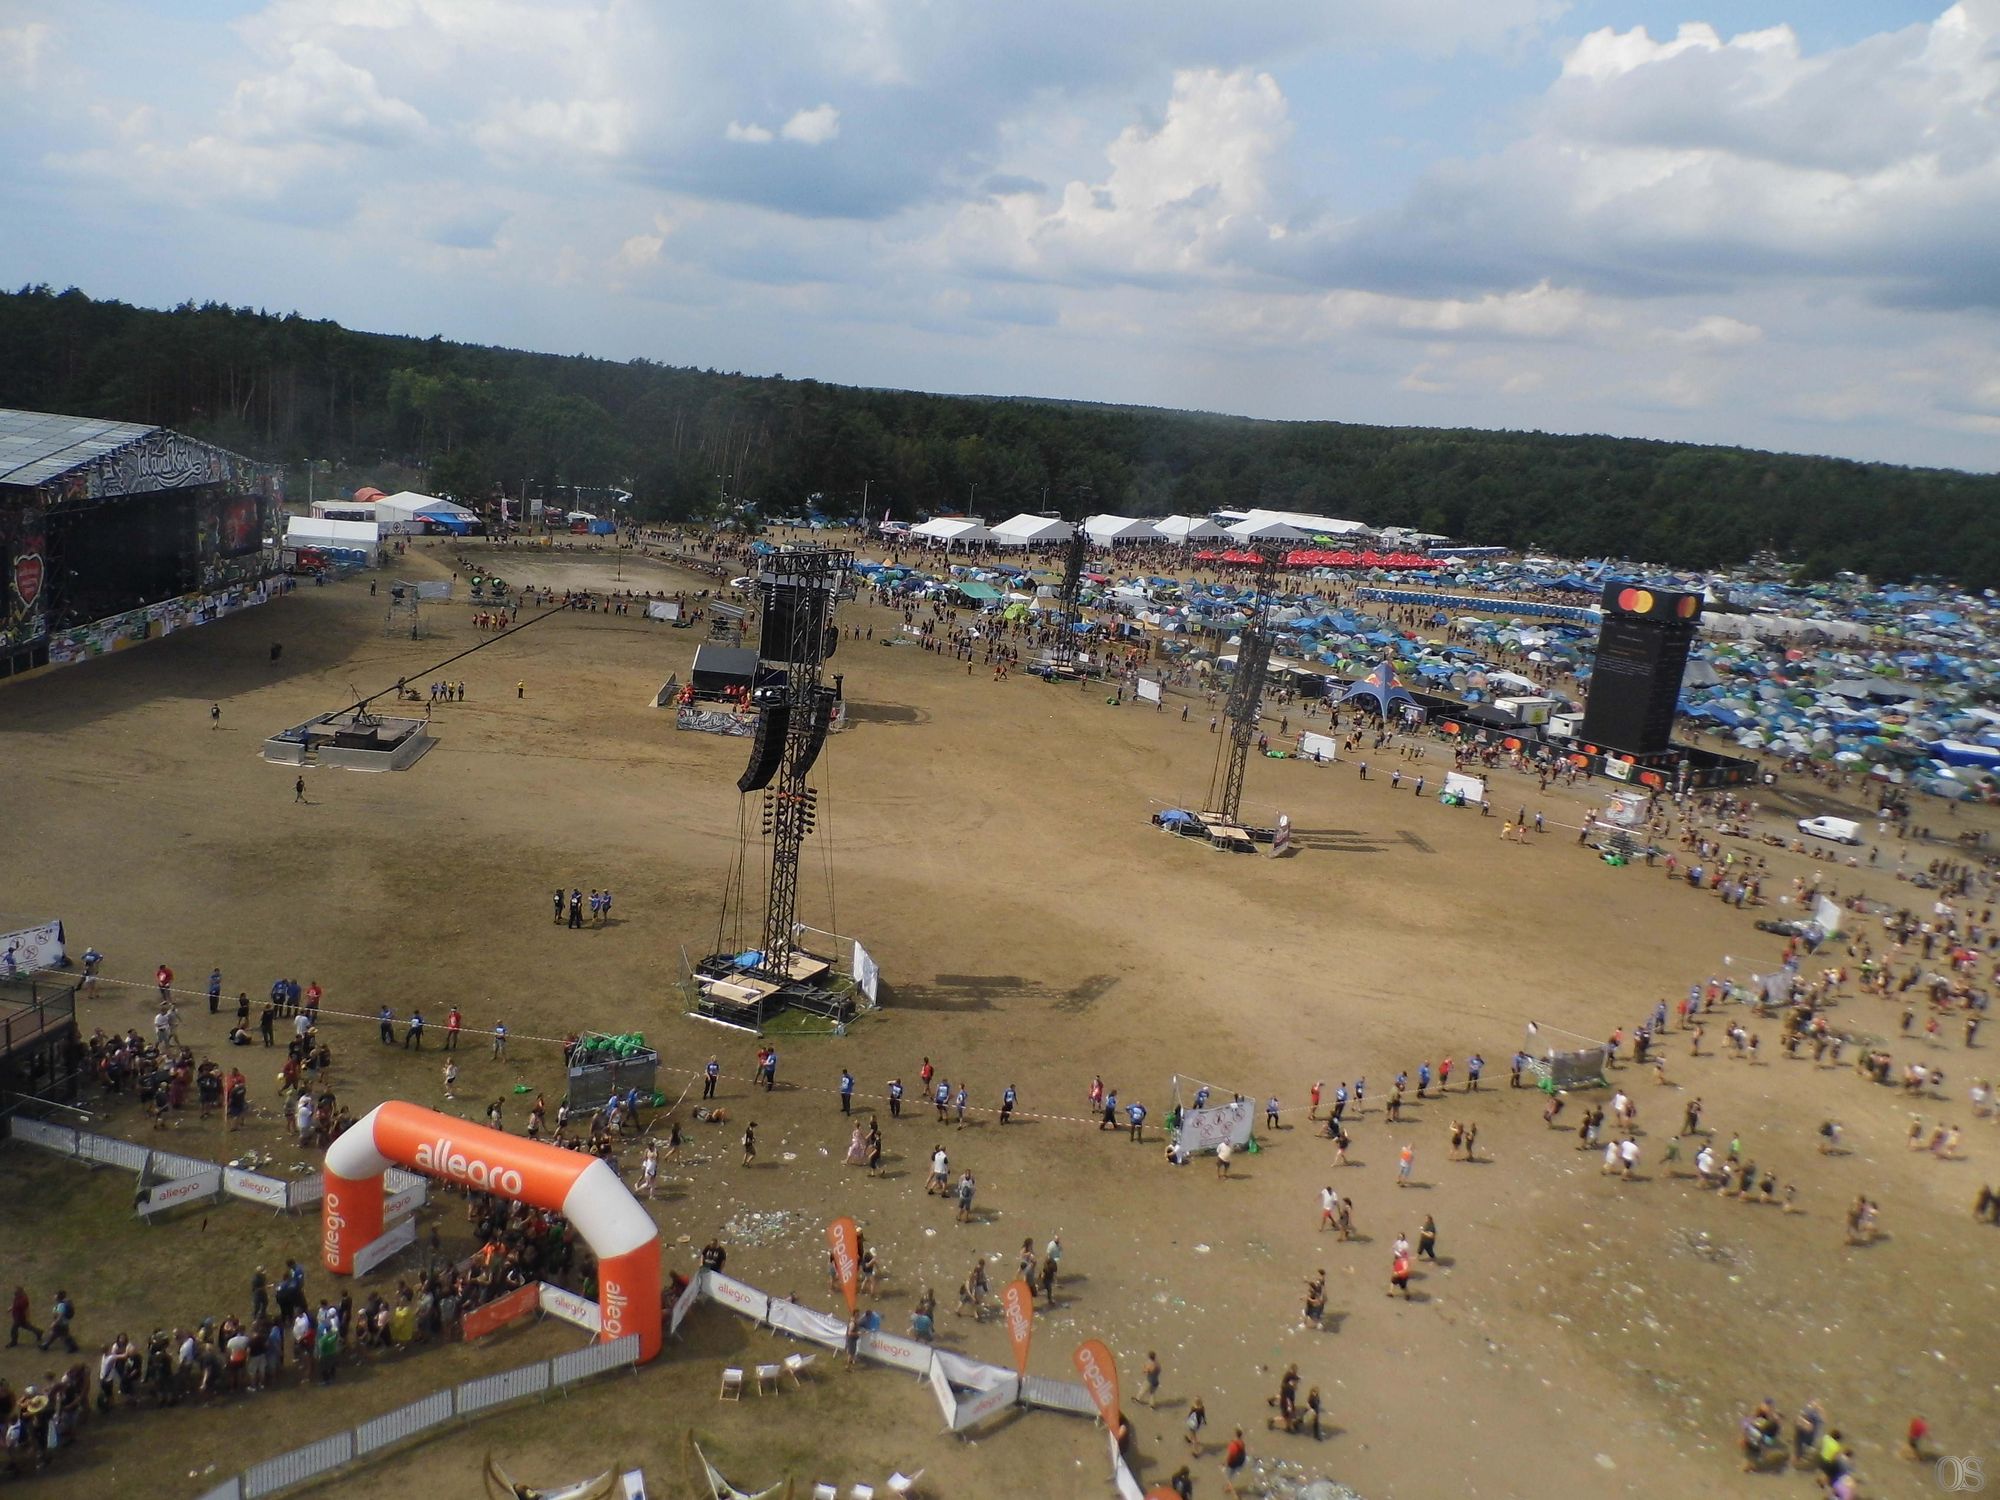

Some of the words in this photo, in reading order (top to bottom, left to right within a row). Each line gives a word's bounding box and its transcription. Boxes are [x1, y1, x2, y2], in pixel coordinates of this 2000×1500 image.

[415, 1138, 522, 1195] allegro
[159, 1181, 200, 1202] allegro
[239, 1178, 271, 1194] allegro
[384, 1197, 411, 1214] llegro
[326, 1193, 346, 1266] allegro
[719, 1283, 751, 1303] allegro
[554, 1298, 587, 1317] allegro
[870, 1338, 910, 1358] allegro
